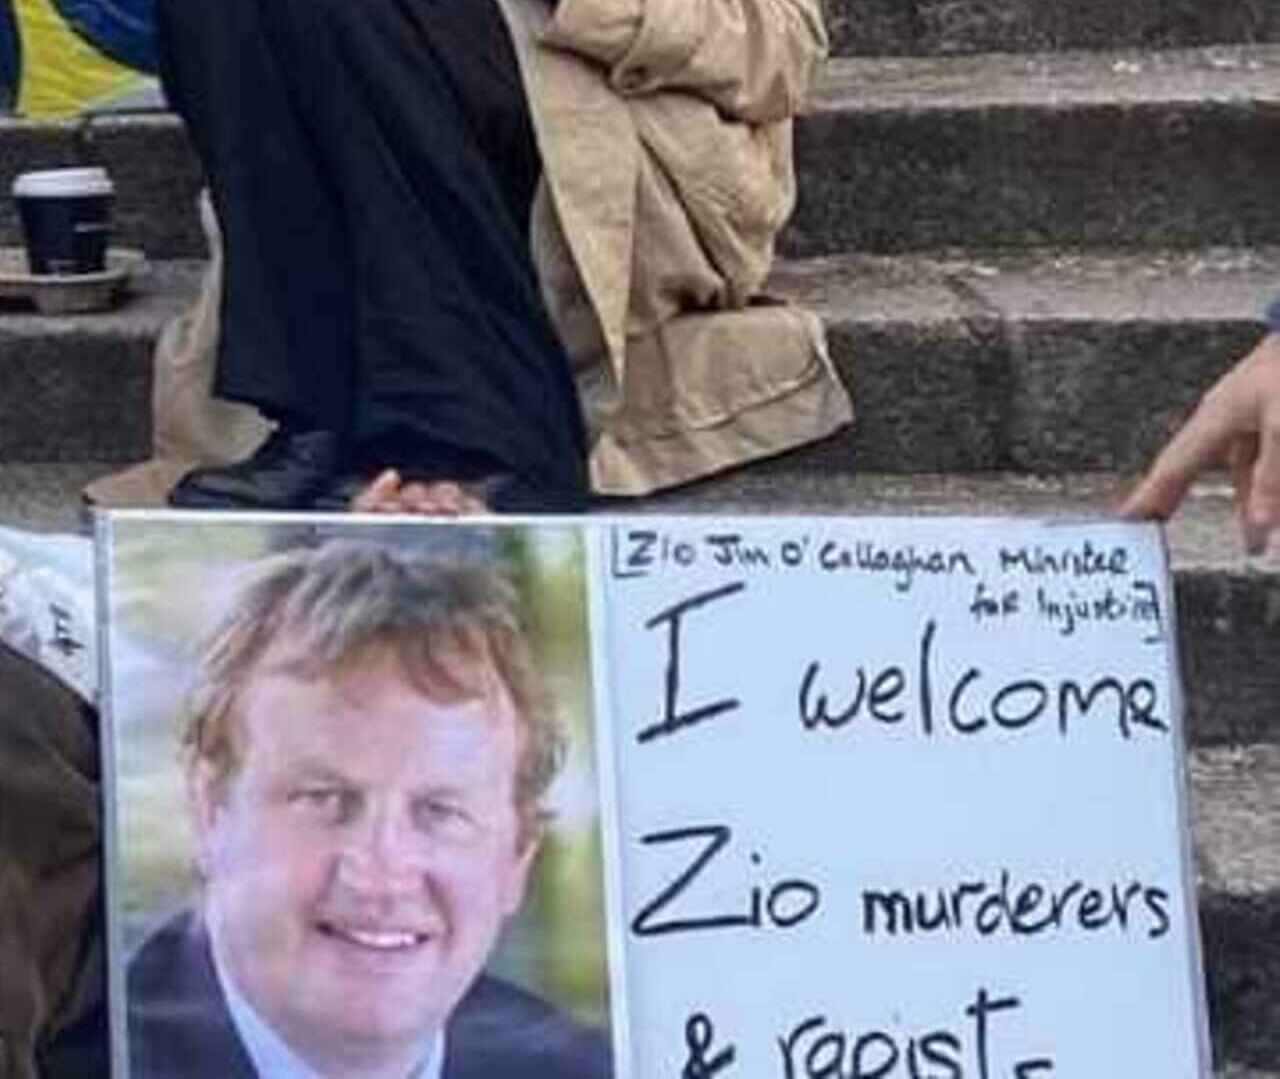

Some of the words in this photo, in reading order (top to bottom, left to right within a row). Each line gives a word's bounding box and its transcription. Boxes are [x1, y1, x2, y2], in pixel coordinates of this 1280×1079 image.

[704, 533, 771, 567] Jim
[636, 582, 745, 745] I
[798, 619, 1169, 738] welcome
[630, 824, 821, 937] Zio
[861, 867, 1173, 940] murderers
[682, 1012, 736, 1079] &
